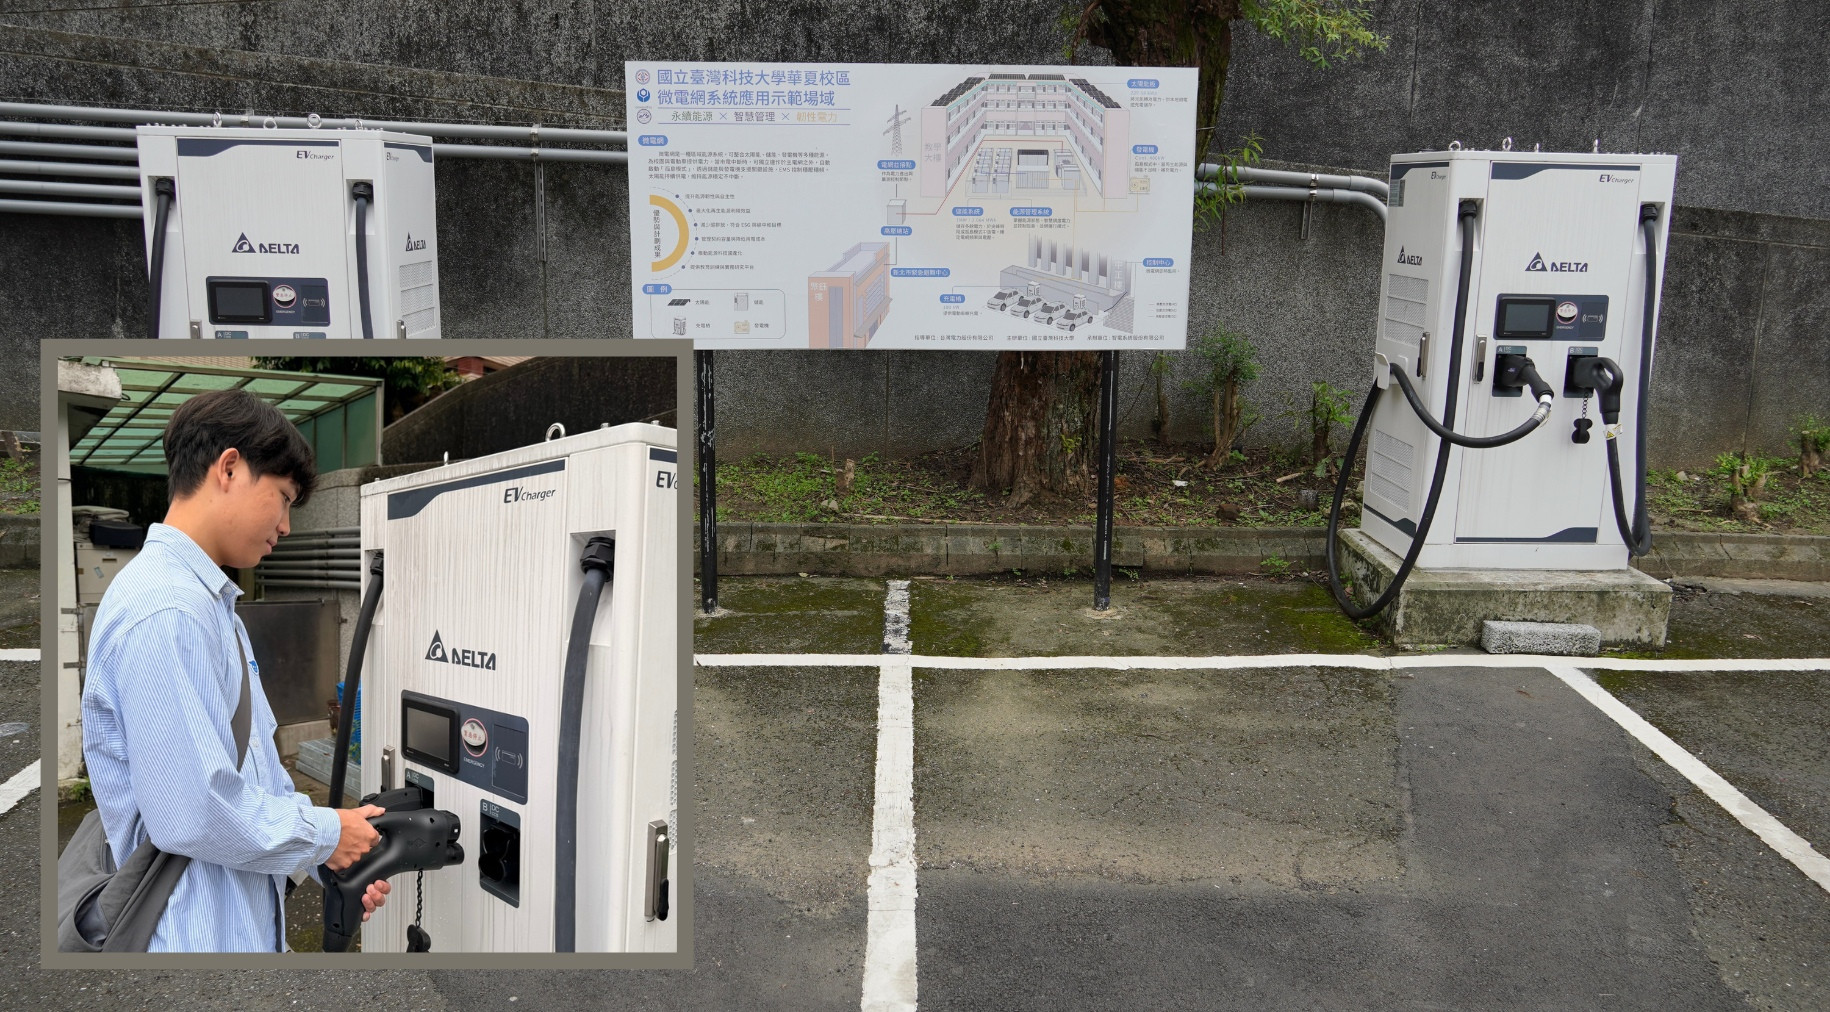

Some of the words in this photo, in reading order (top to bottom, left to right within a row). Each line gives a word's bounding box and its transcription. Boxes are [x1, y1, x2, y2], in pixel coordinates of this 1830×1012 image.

[657, 69, 851, 86] 國立臺灣科技大學華夏校區
[657, 89, 835, 107] 微電網系統應用示範場域
[671, 110, 713, 122] 永續能源
[734, 110, 776, 122] 智慧管理
[642, 136, 665, 145] 微電網
[296, 150, 311, 159] EV
[1599, 174, 1613, 183] EV
[259, 243, 300, 254] DELTA
[1407, 254, 1422, 266] DELTA
[1550, 262, 1588, 272] DELTA
[503, 486, 524, 504] EV
[521, 488, 556, 502] Charger
[451, 647, 496, 671] DELTA
[463, 757, 485, 769] EMERGENCY
[482, 802, 488, 812] B
[491, 804, 499, 813] DC
